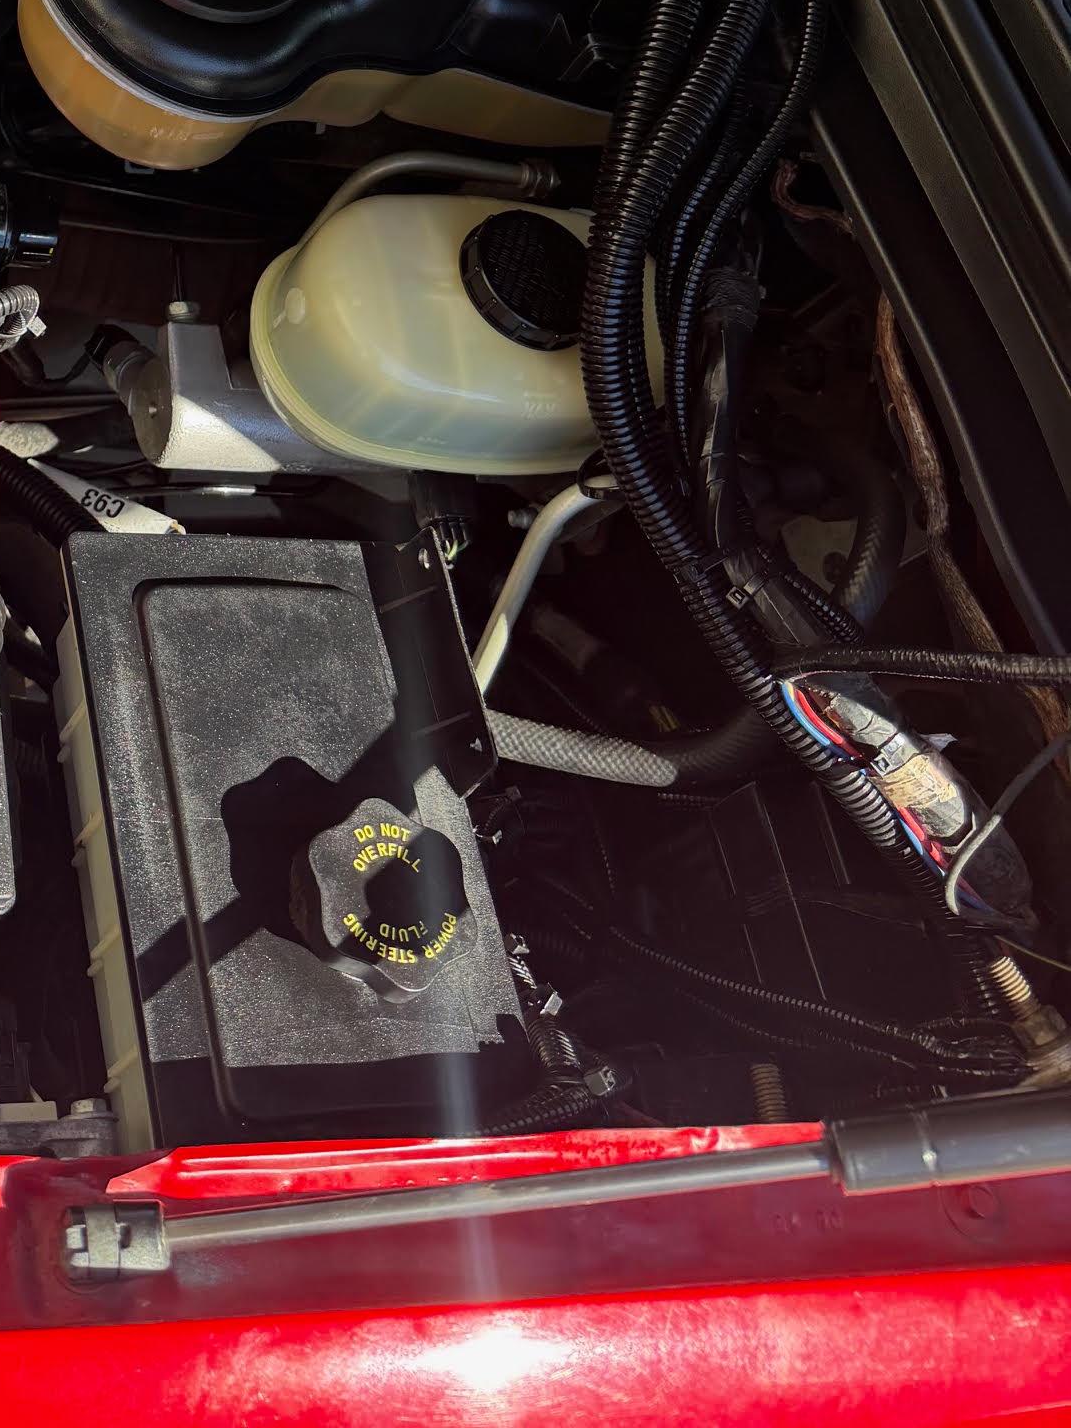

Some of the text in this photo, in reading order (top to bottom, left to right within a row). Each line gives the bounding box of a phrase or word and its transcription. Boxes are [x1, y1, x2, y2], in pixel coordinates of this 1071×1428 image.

[81, 488, 125, 518] C93
[353, 823, 411, 843] DO NOT
[353, 842, 421, 872] OVERFILL
[343, 912, 457, 964] POWER STEERING
[380, 920, 428, 942] FLUID
